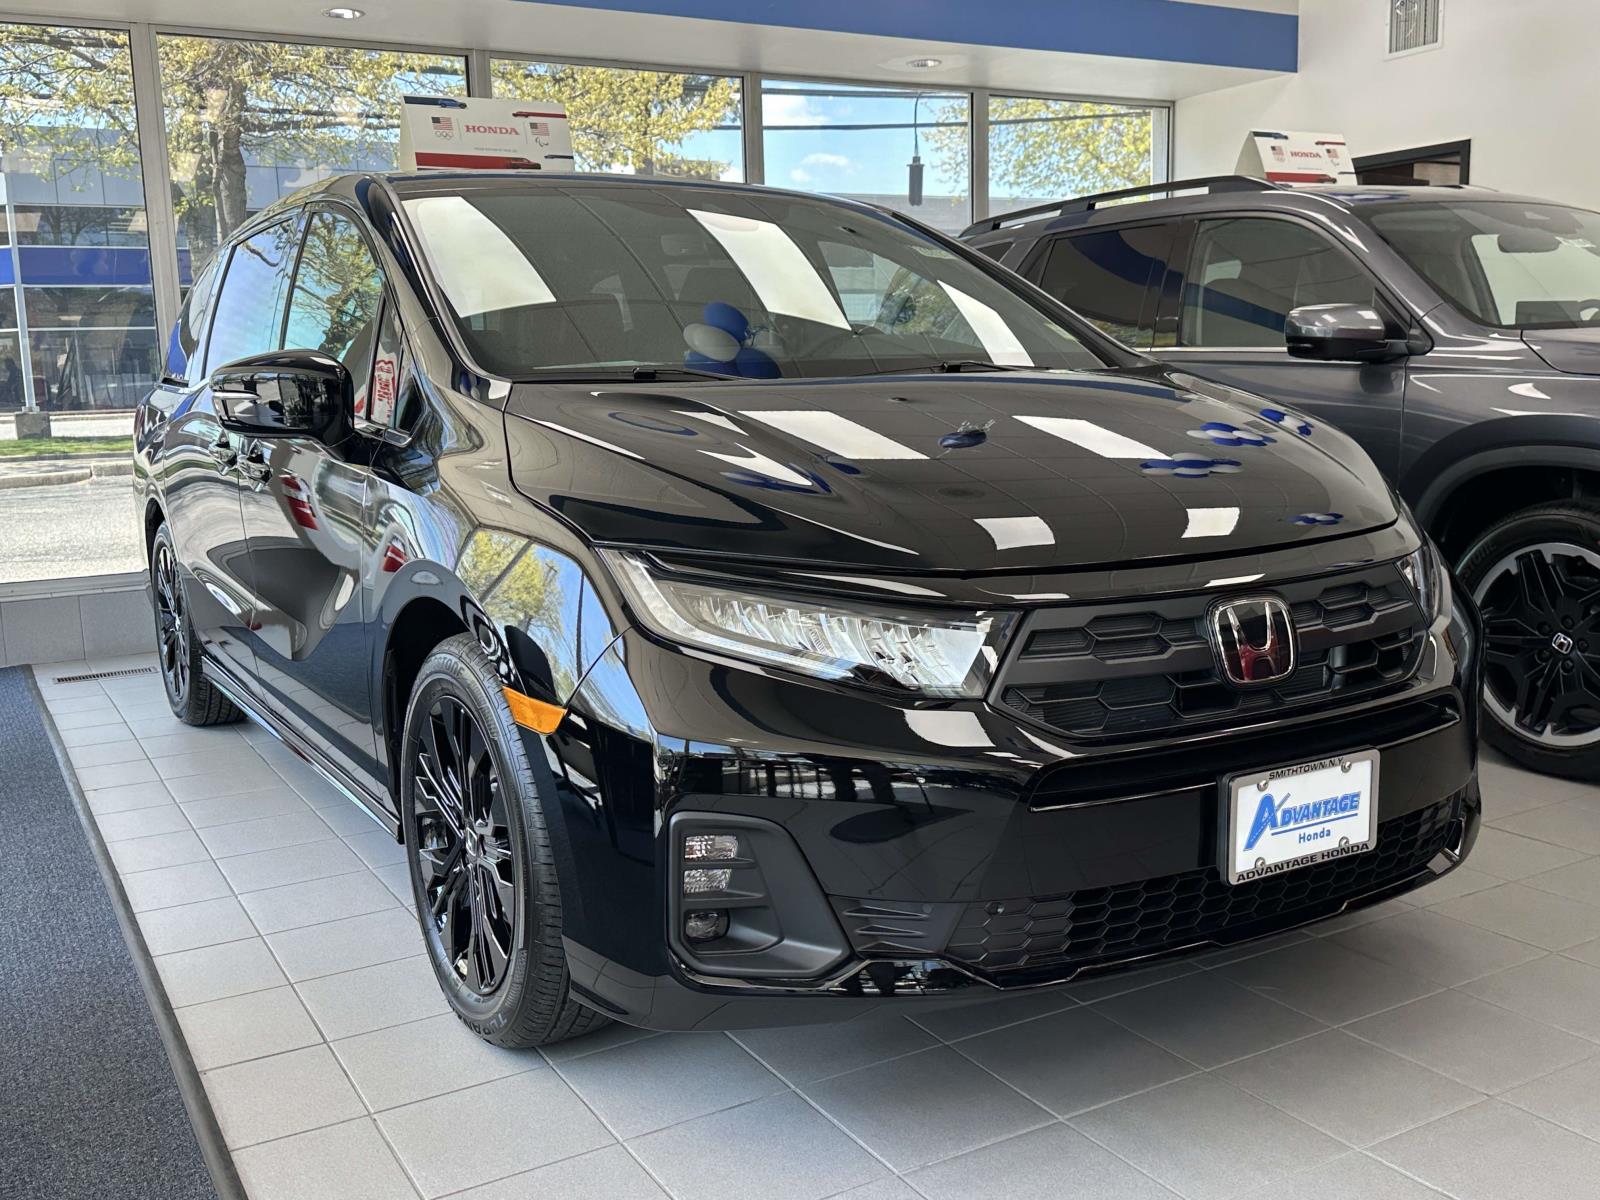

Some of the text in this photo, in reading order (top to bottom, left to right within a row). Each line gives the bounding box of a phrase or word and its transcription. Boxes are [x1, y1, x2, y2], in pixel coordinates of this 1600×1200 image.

[464, 124, 520, 136] HONDA
[1290, 151, 1322, 159] HONDA
[1243, 792, 1361, 851] ADVANTAGE
[1298, 827, 1331, 843] Honda
[1236, 843, 1369, 882] ADVANTAGE HONDA
